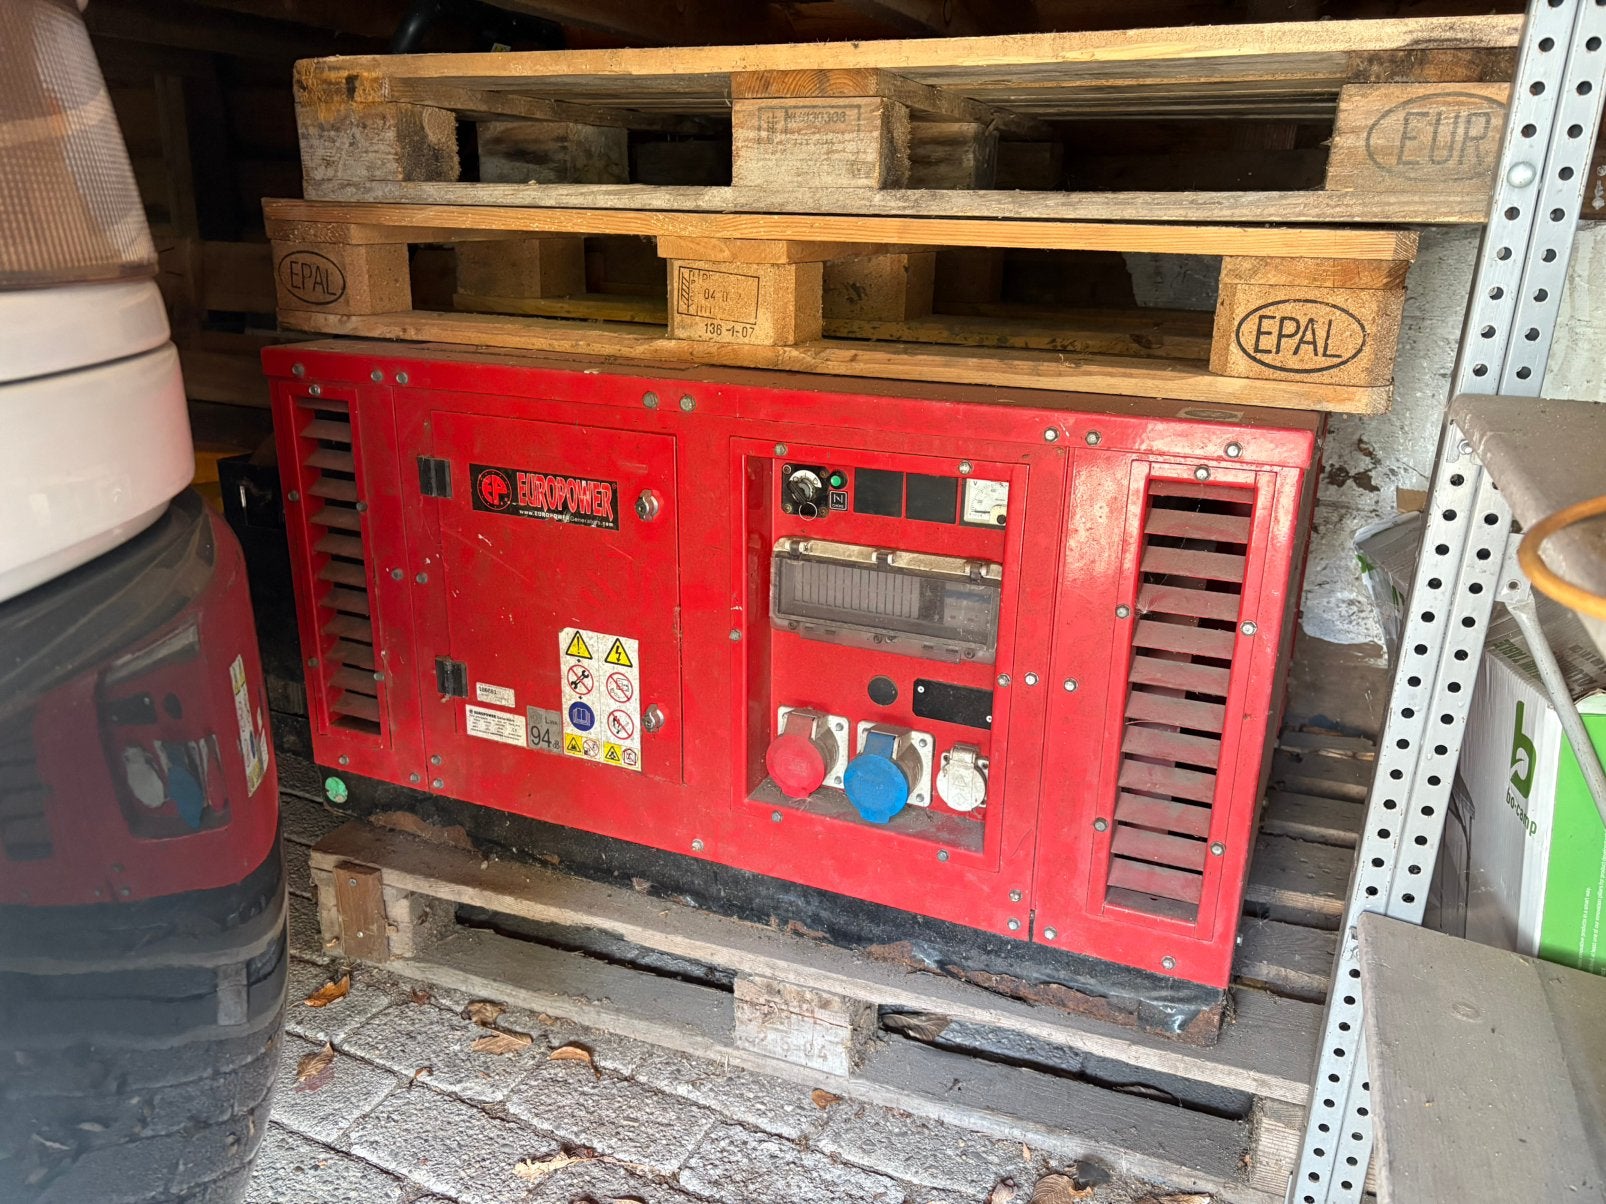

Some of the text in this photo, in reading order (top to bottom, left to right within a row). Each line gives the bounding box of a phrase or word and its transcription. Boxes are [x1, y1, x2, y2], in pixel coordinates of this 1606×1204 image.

[1396, 111, 1492, 166] EUR
[289, 261, 337, 296] EPAL
[1253, 314, 1343, 359] EPAL
[516, 471, 614, 522] EUROPOWER
[530, 725, 552, 748] 94
